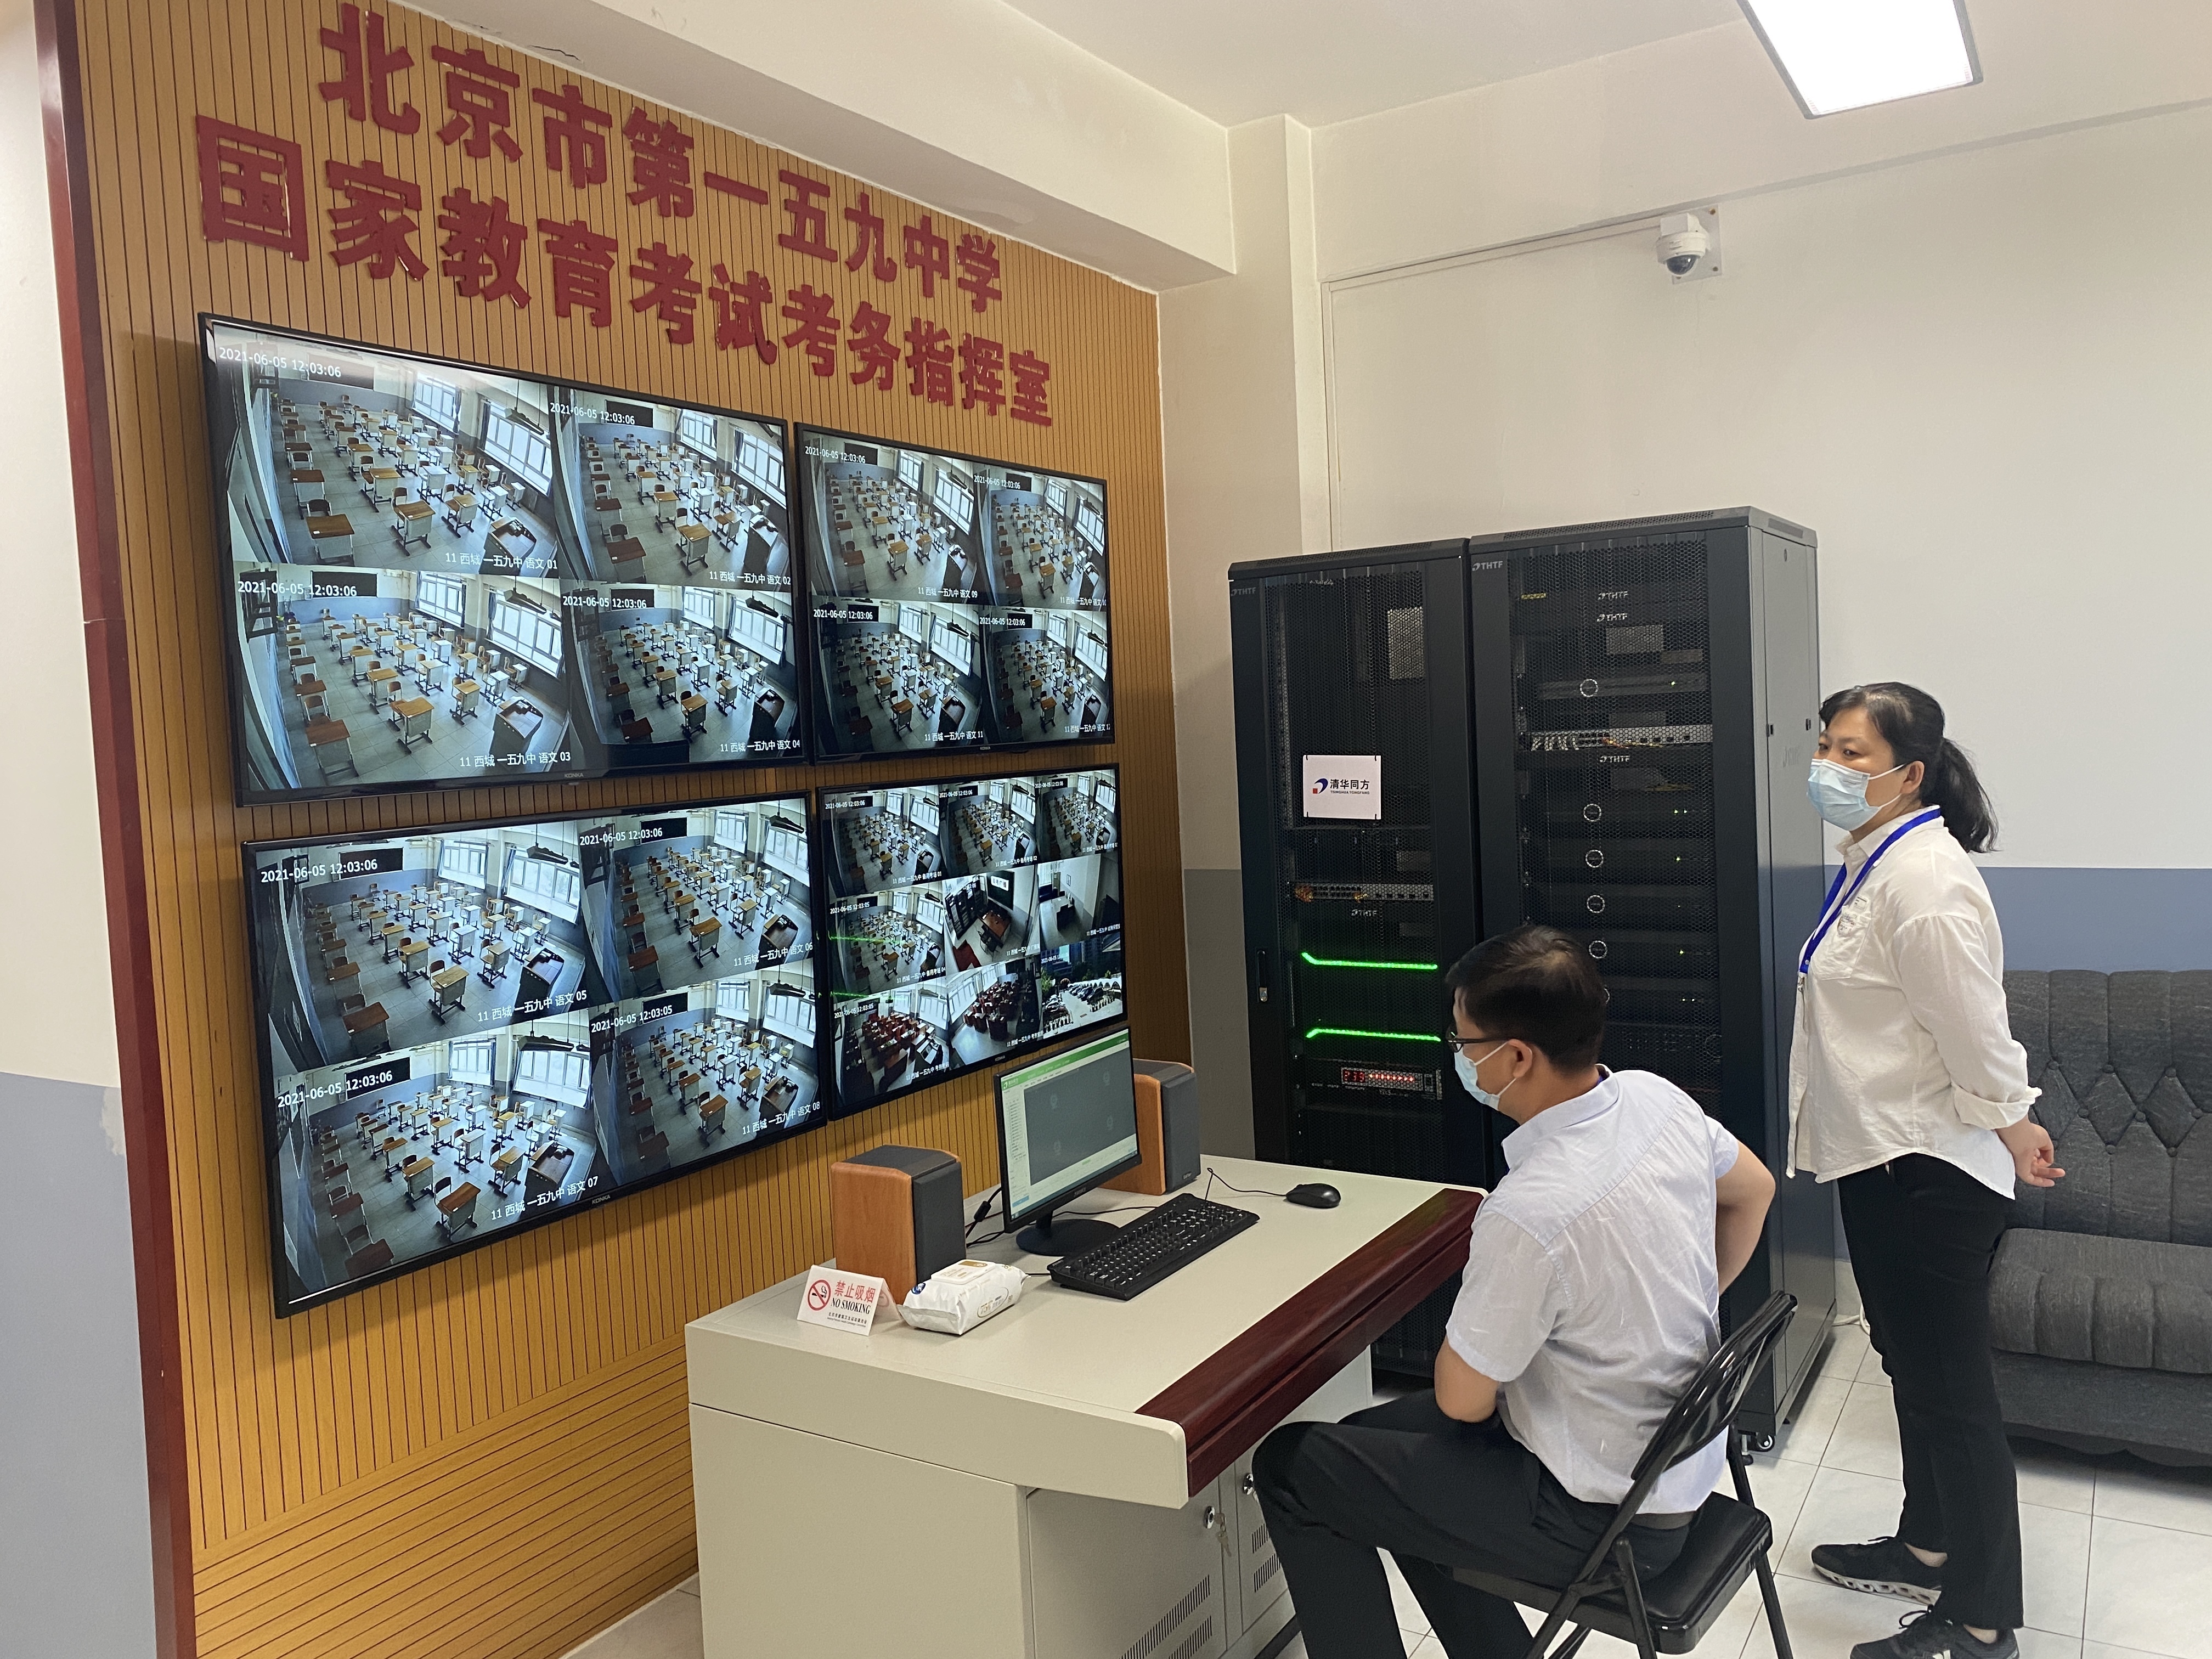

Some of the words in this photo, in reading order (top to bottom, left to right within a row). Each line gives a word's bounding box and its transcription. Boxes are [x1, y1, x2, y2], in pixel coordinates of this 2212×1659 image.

[318, 2, 1001, 311] 北京市第一五九中学
[196, 114, 1052, 426] 国家教育考试考务指挥室
[219, 347, 287, 369] 2021-06-05
[292, 360, 341, 377] 12:03:06
[550, 403, 597, 419] 2021-06-05
[600, 411, 635, 425] 12:03:06
[805, 446, 838, 459] 2021-06-05
[840, 452, 865, 463] 12:03:06
[974, 475, 1000, 486] 2021-06-05
[1001, 479, 1020, 489] 12:03:06
[445, 552, 456, 562] 11
[460, 552, 481, 565] 西城
[483, 555, 522, 567] 一五九中
[526, 557, 544, 570] 语文
[548, 560, 557, 569] 01
[1481, 560, 1503, 569] THTF
[709, 571, 718, 580] 11
[720, 571, 735, 582] 西城
[737, 573, 765, 584] 一五九中
[768, 574, 781, 585] 语文
[782, 576, 791, 585] 02
[238, 581, 304, 594] 2021-06-05
[308, 584, 357, 597] 12:03:06
[938, 588, 958, 597] 一五九中
[1237, 587, 1256, 596] THTF
[563, 596, 610, 608] 2021-06-05
[612, 598, 647, 609] 12:03:06
[1075, 597, 1092, 606] 一五九中
[814, 610, 847, 618] 2021-06-05
[944, 732, 965, 741] 一五九中
[720, 743, 728, 752] 11
[730, 742, 746, 752] 西城
[747, 741, 776, 752] 一五九中
[777, 740, 791, 751] 语文
[792, 740, 800, 749] 04
[460, 757, 471, 767] 11
[474, 755, 495, 768] 西城
[497, 753, 536, 766] 一五九中
[539, 752, 557, 763] 语文
[560, 752, 571, 761] 03
[1330, 779, 1369, 789] 清华同方
[825, 800, 848, 809] 2021-06-05
[580, 831, 625, 845] 2021-06-05
[628, 827, 663, 840] 12:03:06
[261, 864, 326, 883] 2021-06-05
[330, 859, 377, 874] 12:03:06
[830, 905, 852, 915] 2021-06-05
[734, 958, 742, 967] 11
[744, 954, 759, 966] 西城
[760, 947, 788, 961] 一五九中
[789, 944, 804, 955] 语文
[805, 942, 813, 952] 06
[478, 1012, 489, 1022] 11
[492, 1005, 512, 1021] 西城
[515, 997, 552, 1013] 一五九中
[555, 992, 574, 1007] 语文
[576, 990, 587, 1001] 05
[591, 1014, 636, 1033] 2021-06-05
[639, 1005, 673, 1020] 12:03:05
[278, 1082, 342, 1107] 2021-06-05
[346, 1070, 393, 1091] 12:03:06
[742, 1126, 750, 1135] 11
[753, 1120, 767, 1132] 西城
[768, 1110, 796, 1126] 一五九中
[797, 1104, 811, 1116] 语文
[812, 1102, 820, 1110] 08
[492, 1209, 503, 1221] 11
[505, 1200, 526, 1217] 西城
[527, 1187, 565, 1207] 一五九中
[567, 1181, 586, 1196] 语文
[588, 1176, 599, 1188] 07
[834, 1280, 876, 1304] 禁止吸烟
[831, 1297, 840, 1308] NO
[840, 1300, 871, 1314] SMOKING
